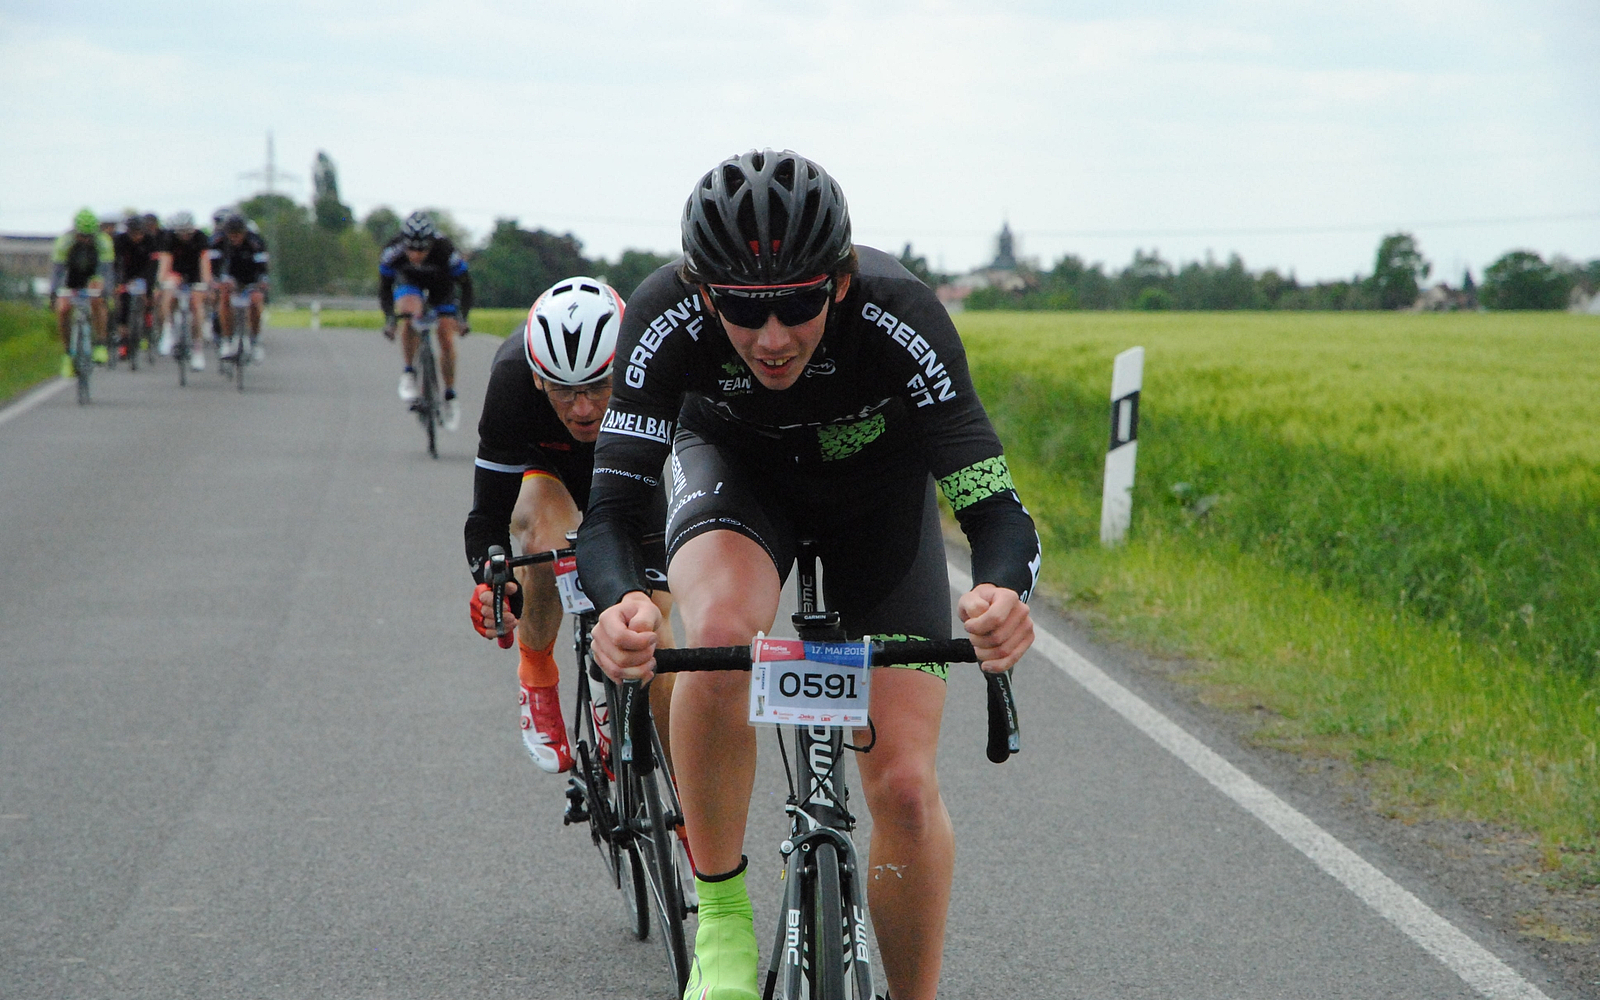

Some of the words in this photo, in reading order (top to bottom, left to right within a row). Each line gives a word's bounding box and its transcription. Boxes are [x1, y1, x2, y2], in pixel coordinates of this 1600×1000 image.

[906, 373, 935, 408] FIT
[600, 408, 673, 446] CAMELBAK
[811, 645, 823, 655] 17.
[824, 646, 843, 656] MAI
[843, 647, 866, 656] 2015
[779, 672, 858, 699] 0591
